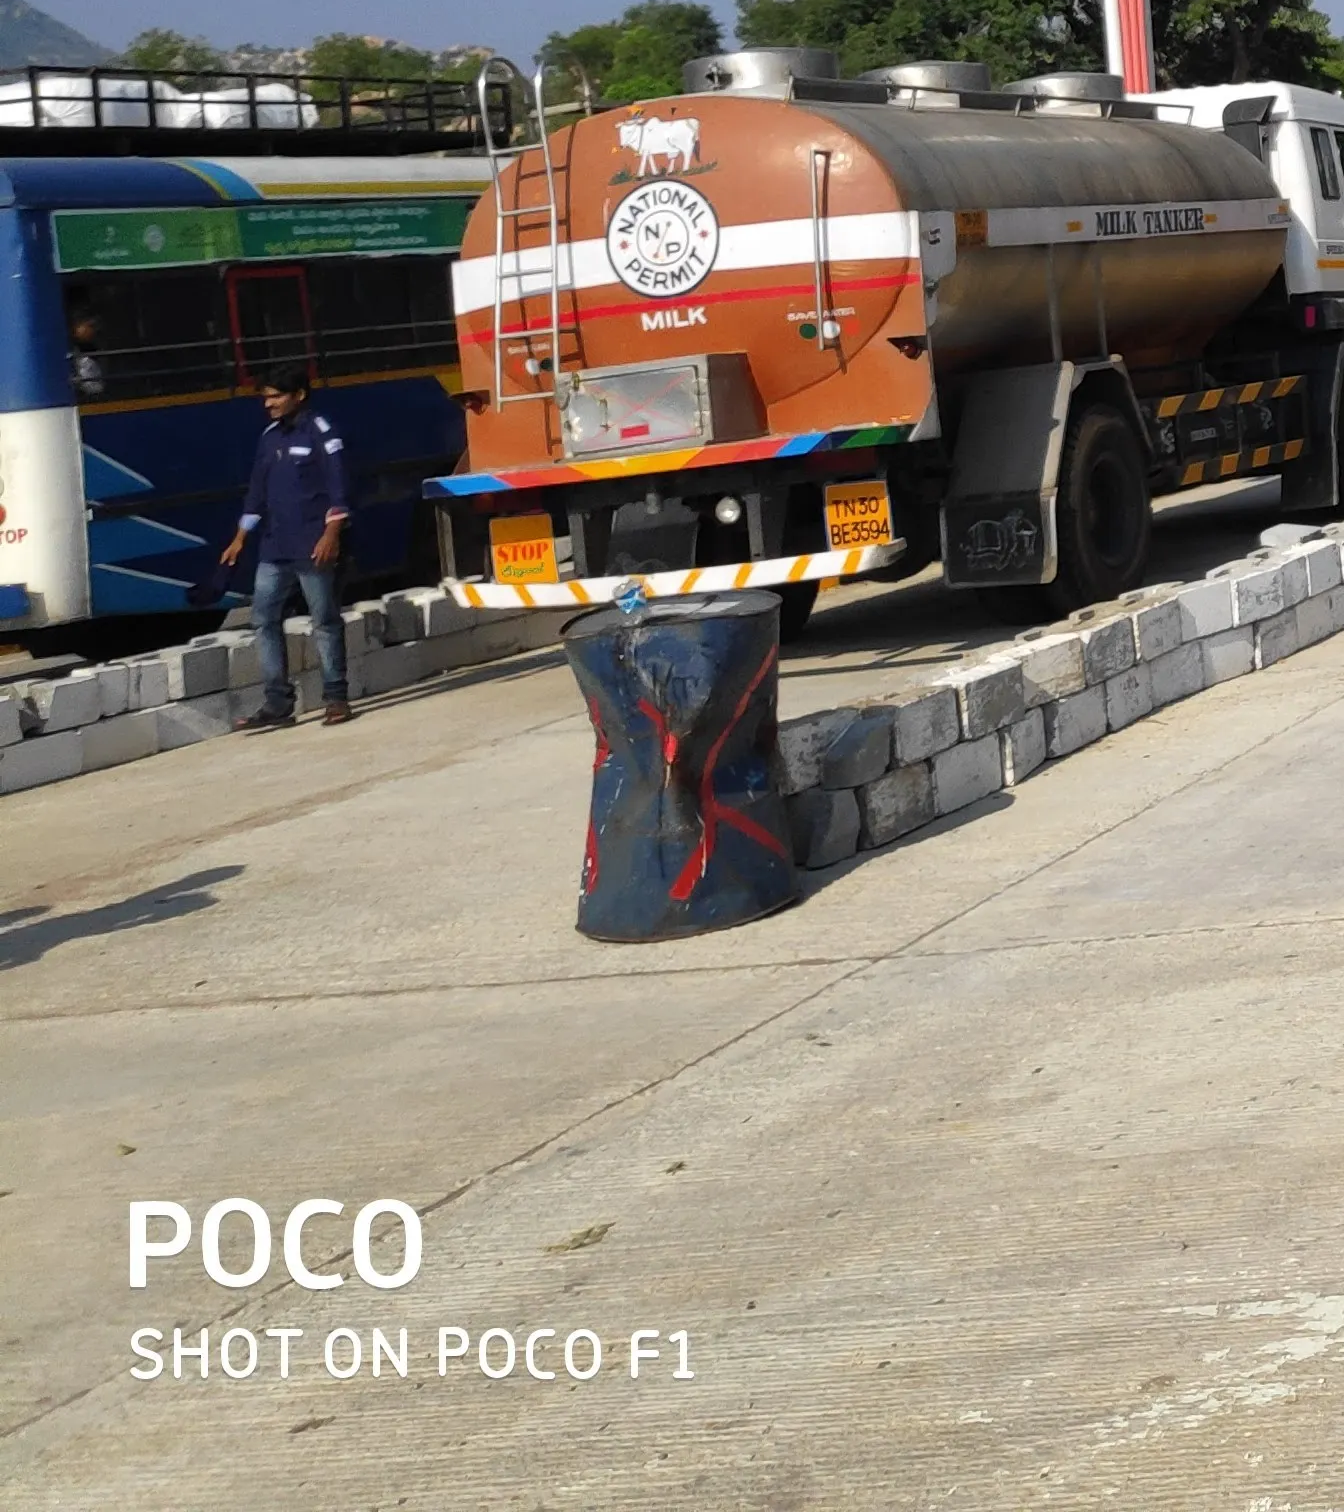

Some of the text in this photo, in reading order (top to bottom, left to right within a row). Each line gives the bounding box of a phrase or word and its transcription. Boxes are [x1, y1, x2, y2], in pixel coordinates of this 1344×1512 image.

[618, 188, 705, 235] NATIONAL
[1096, 208, 1204, 236] MILK TANKER
[645, 223, 681, 257] N P
[624, 246, 705, 289] PERMIT
[641, 306, 708, 332] MILK
[832, 496, 880, 519] TN30
[0, 528, 28, 545] TOP
[831, 518, 890, 545] BE3594
[498, 542, 549, 564] STOP
